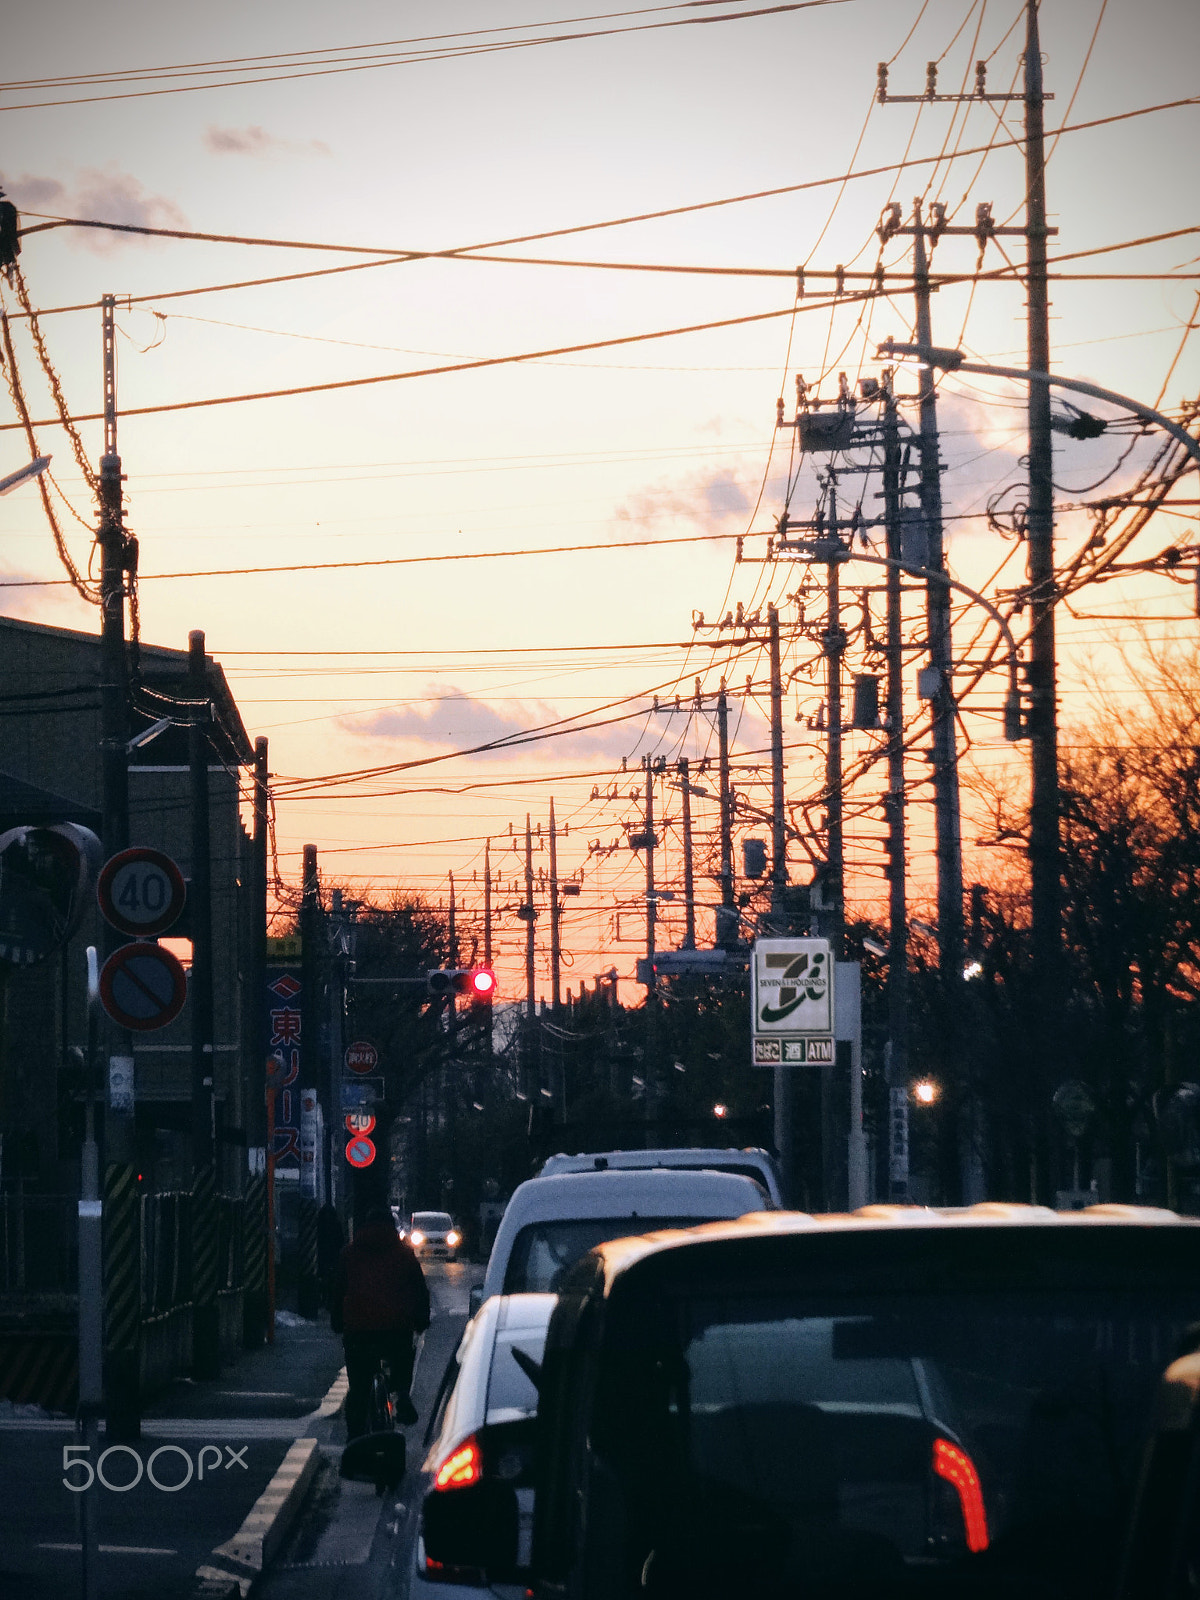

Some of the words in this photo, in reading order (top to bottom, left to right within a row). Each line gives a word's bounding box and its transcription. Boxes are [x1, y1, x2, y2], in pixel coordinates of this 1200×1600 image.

[118, 872, 166, 911] 40
[784, 1041, 802, 1060] 酒
[808, 1041, 831, 1060] ATM
